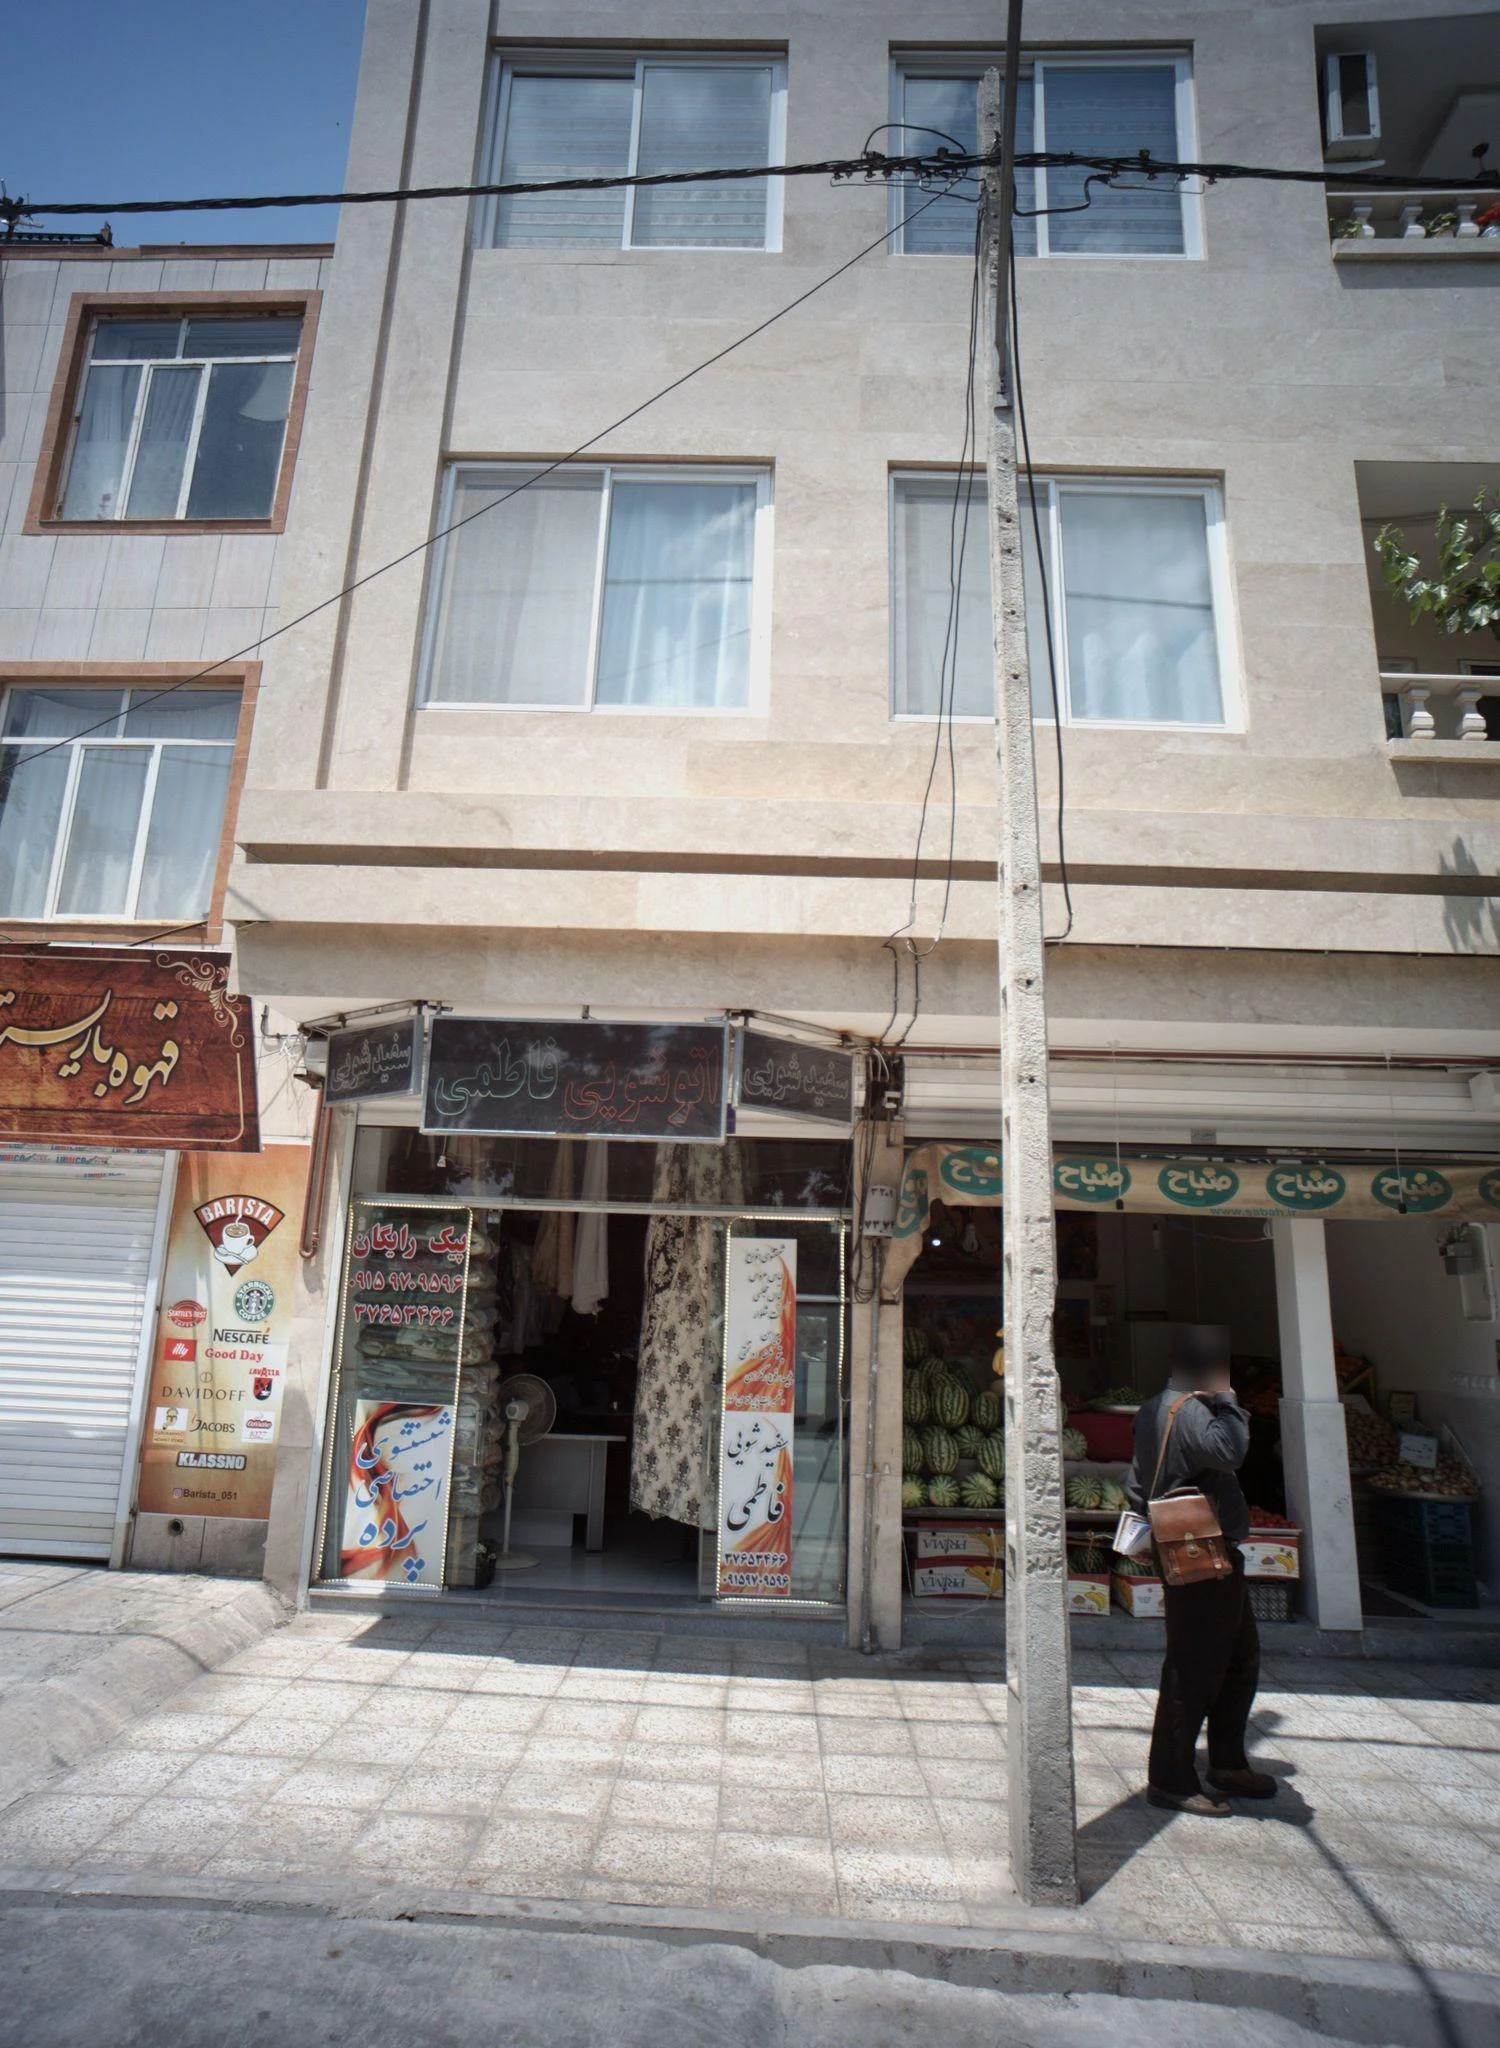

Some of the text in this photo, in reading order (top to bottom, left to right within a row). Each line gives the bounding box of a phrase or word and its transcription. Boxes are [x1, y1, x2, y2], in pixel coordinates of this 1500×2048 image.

[109, 1000, 179, 1104] قهوه
[434, 1036, 560, 1116] فاطمی
[200, 1197, 275, 1227] BARISTA
[353, 1222, 468, 1265] پیک رایگان
[354, 1304, 454, 1327] ۳۷۶۵۳۴۶۶
[172, 1343, 188, 1357] illy
[205, 1348, 264, 1362] Good Day
[162, 1386, 247, 1401] DAVIDOFF
[189, 1419, 235, 1433] JACOBS
[178, 1452, 245, 1469] KLASSNO
[355, 1460, 442, 1509] اختصاصی
[726, 1474, 786, 1532] فاطمی
[359, 1516, 428, 1582] پرده
[724, 1552, 788, 1567] ۳۷۶۵۳۴۶۶
[723, 1573, 789, 1588] ۰۹۱۵۹۷۰۹۵۹۶
